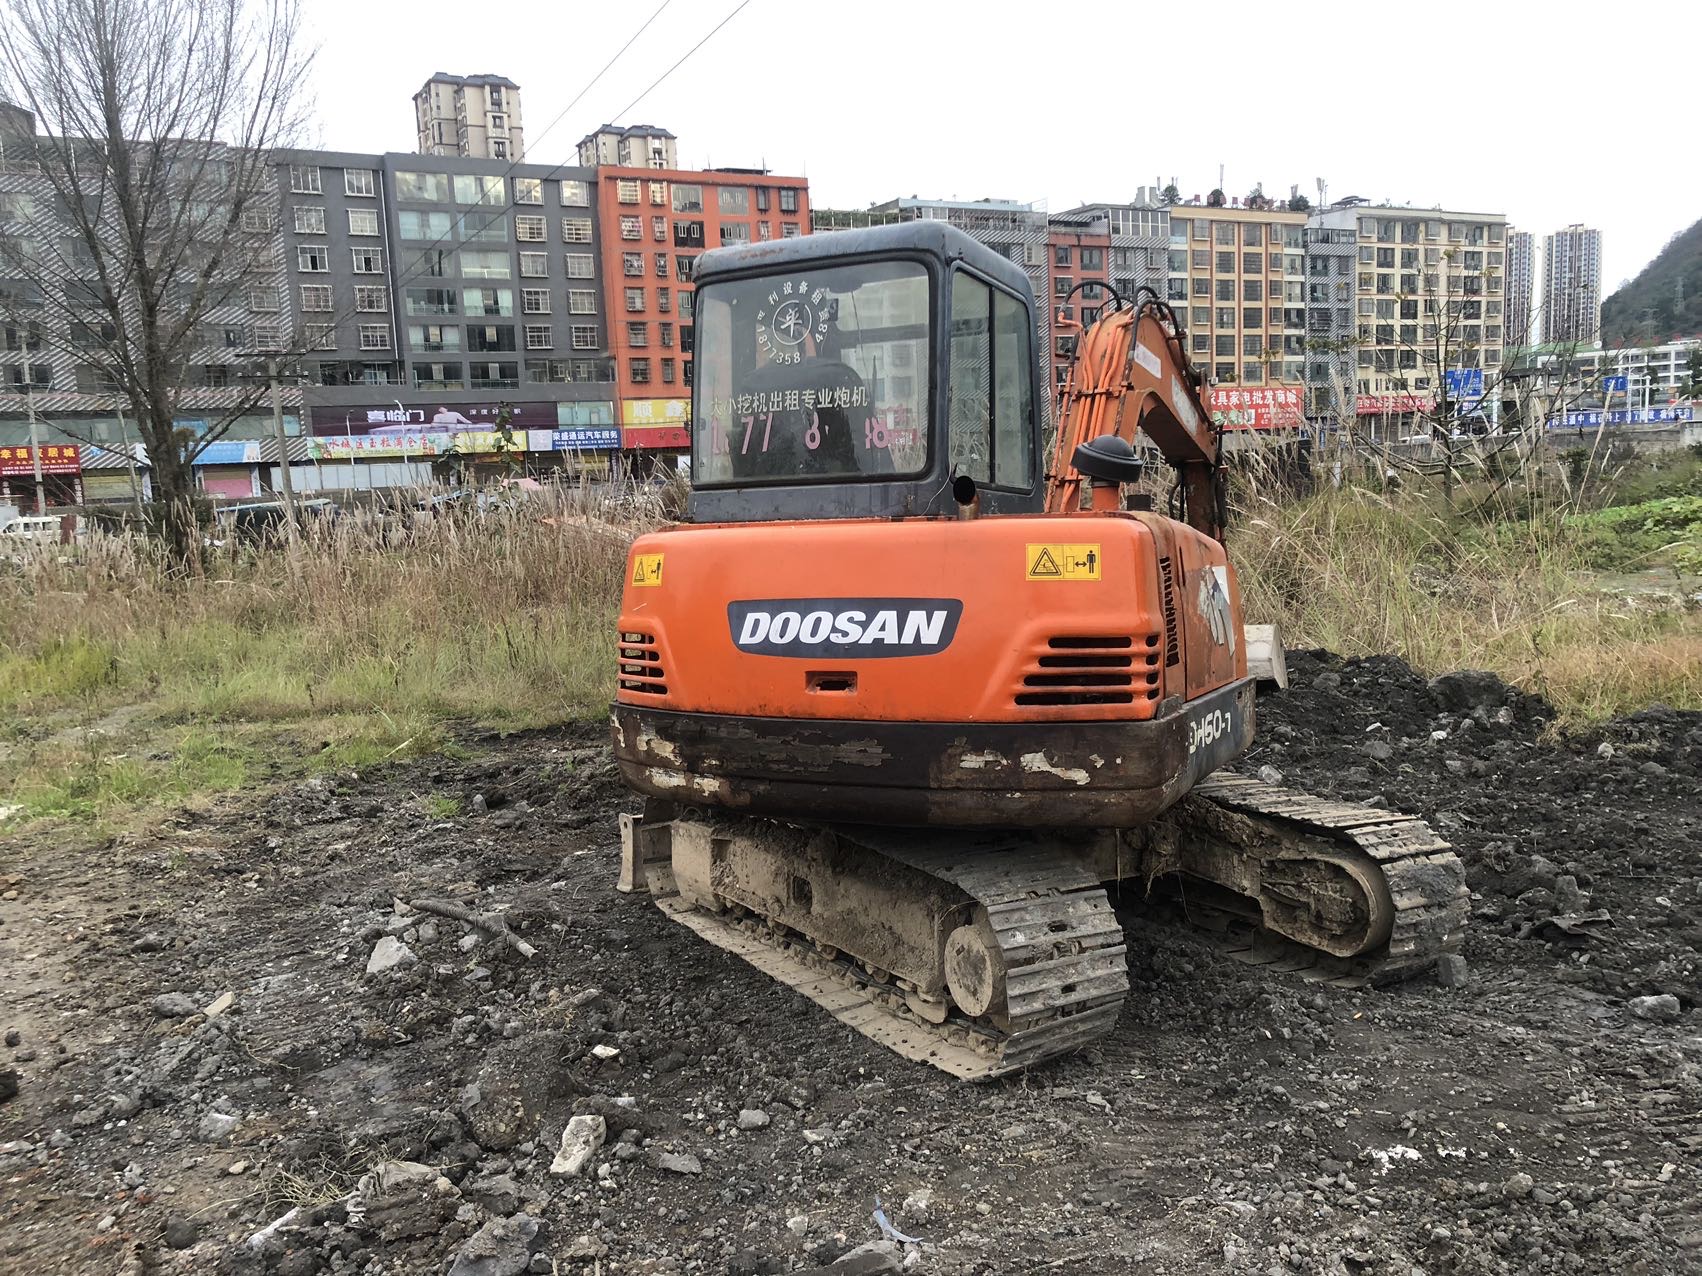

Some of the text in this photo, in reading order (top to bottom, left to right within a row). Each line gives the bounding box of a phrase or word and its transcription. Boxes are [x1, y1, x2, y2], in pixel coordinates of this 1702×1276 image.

[366, 410, 425, 423] 喜临门
[738, 610, 948, 645] DOOSAN
